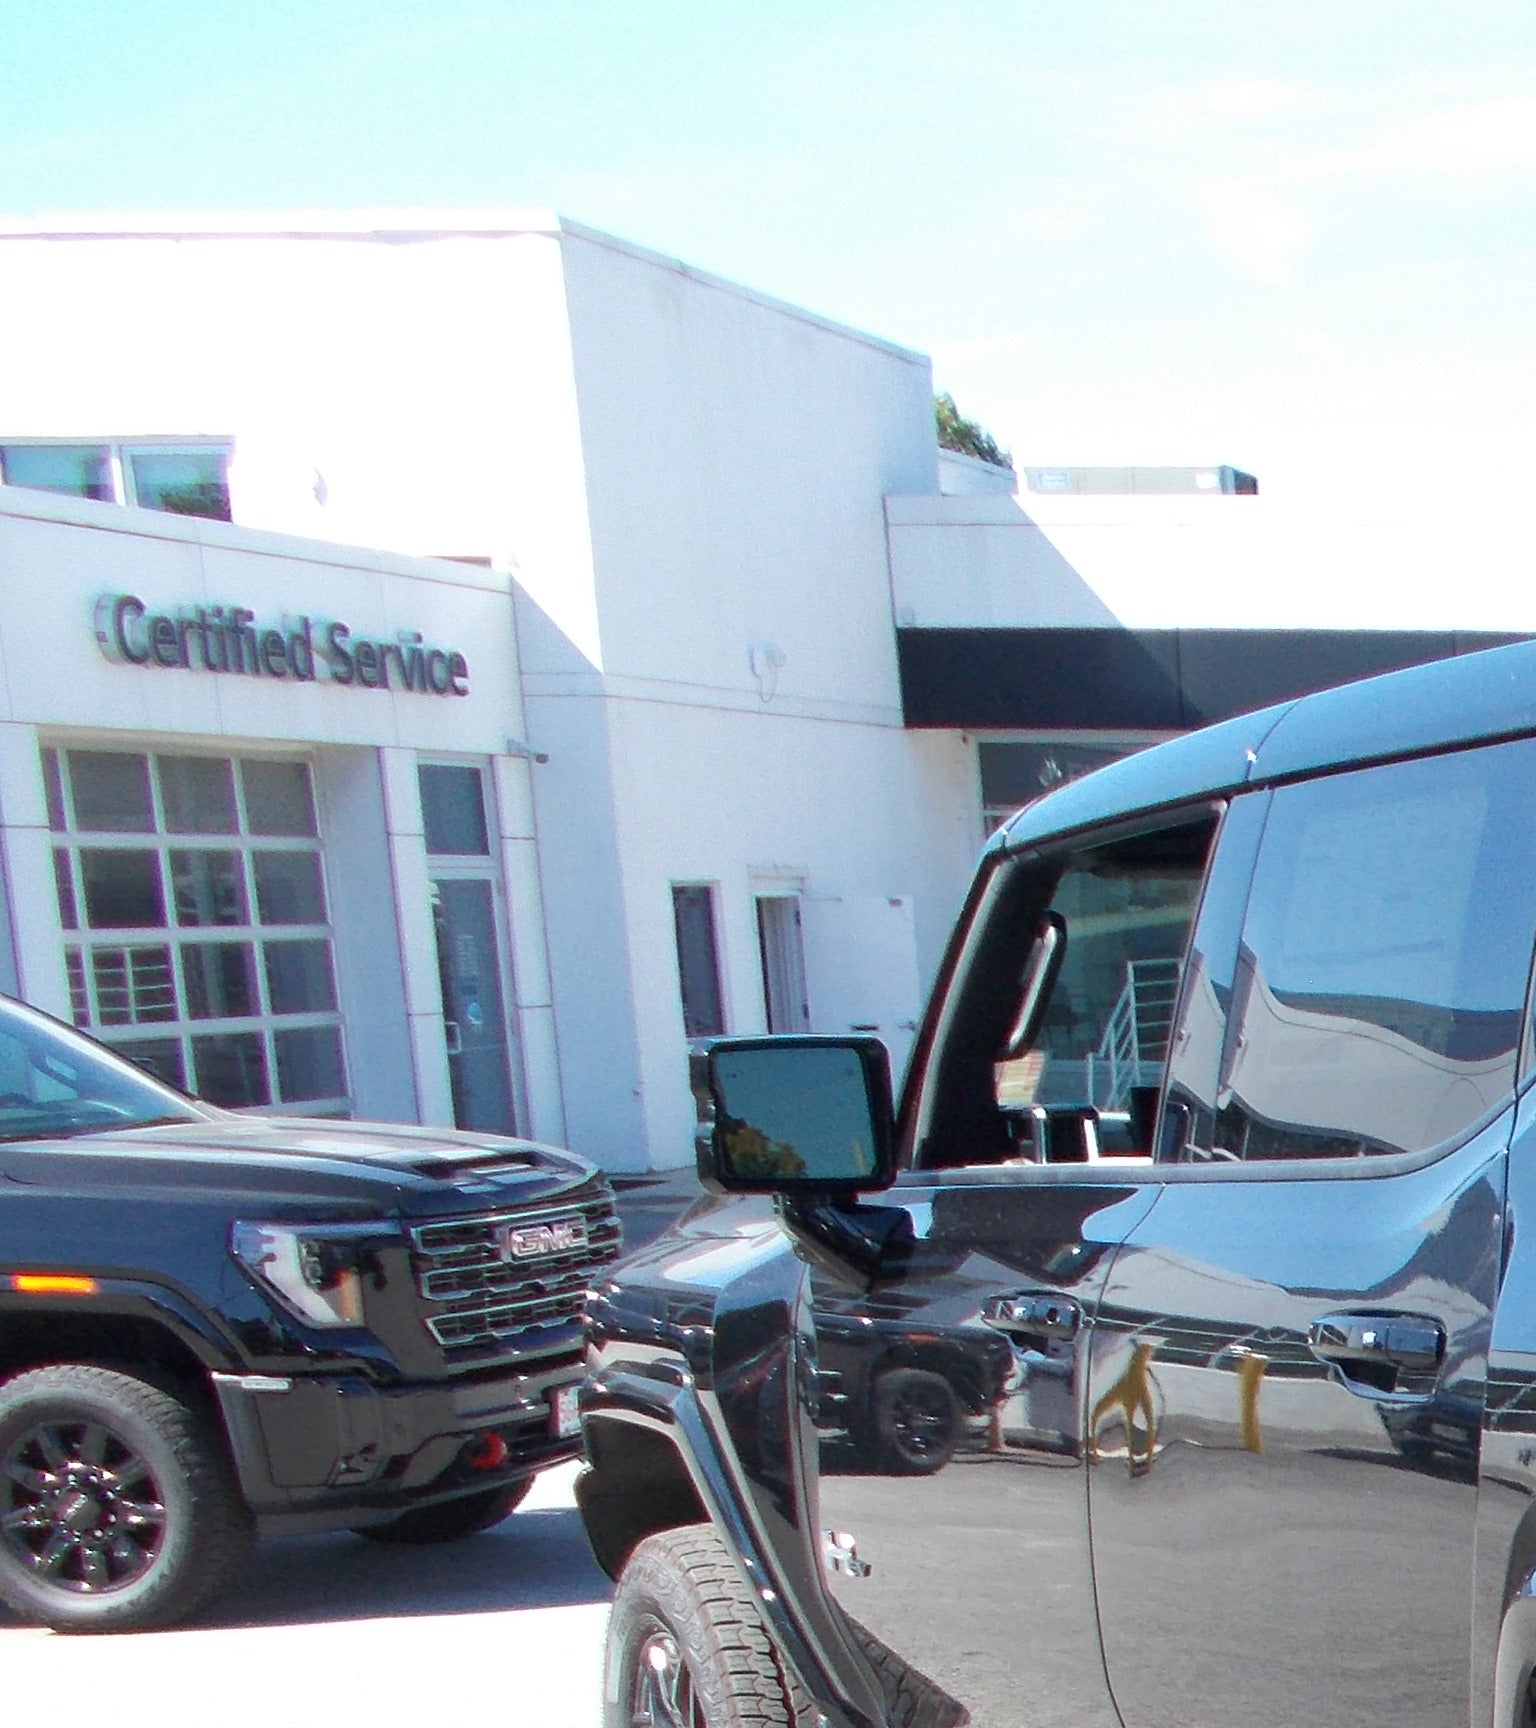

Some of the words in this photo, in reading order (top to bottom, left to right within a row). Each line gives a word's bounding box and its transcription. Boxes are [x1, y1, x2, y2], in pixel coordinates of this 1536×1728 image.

[101, 594, 316, 682] Certified
[325, 621, 471, 697] Service
[509, 1220, 588, 1257] GMC
